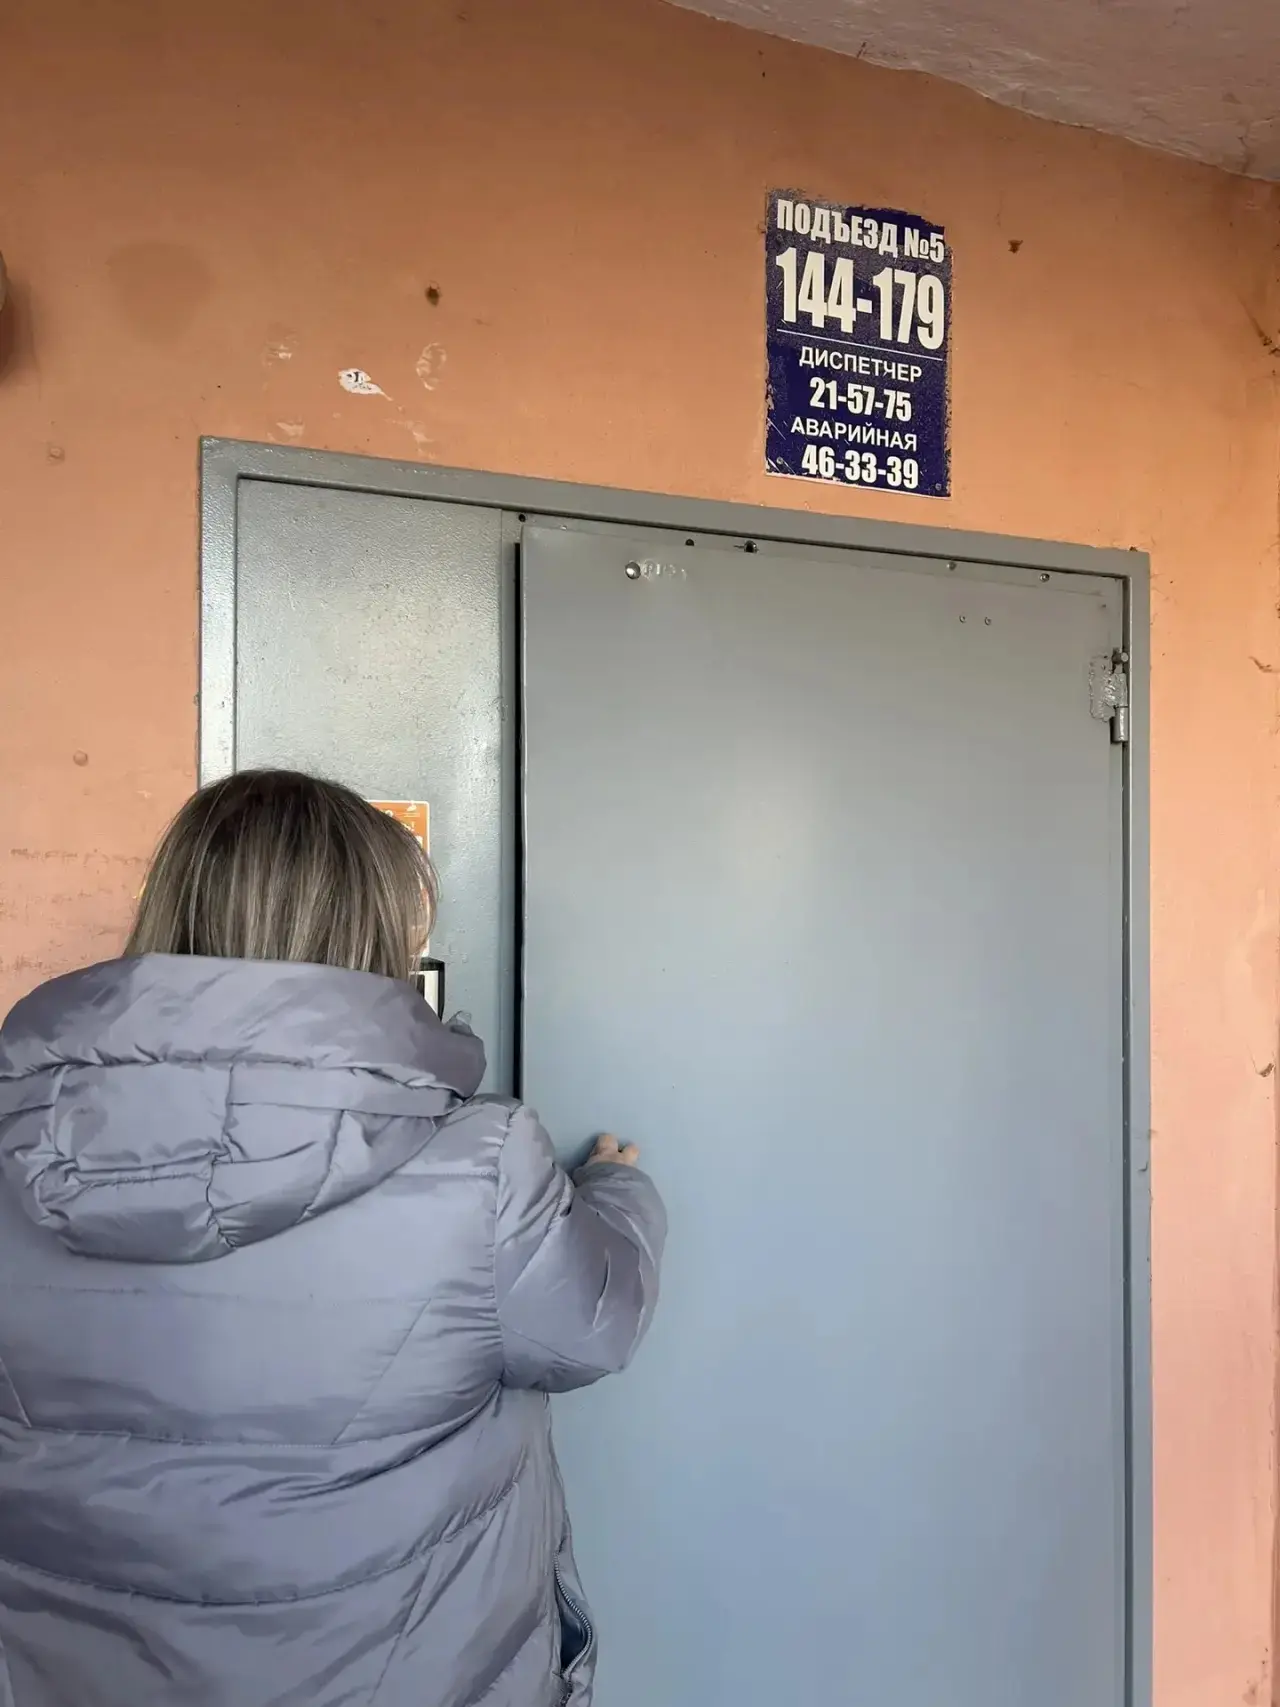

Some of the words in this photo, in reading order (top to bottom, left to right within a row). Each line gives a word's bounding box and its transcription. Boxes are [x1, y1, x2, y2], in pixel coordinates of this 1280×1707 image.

[777, 199, 898, 258] ПОДЪЕЗД
[904, 228, 944, 263] №5
[776, 247, 944, 350] 144-179
[799, 345, 922, 382] ДИСПЕТЧЕР
[809, 377, 912, 422] 21-57-75
[790, 416, 918, 452] АВАРИЙНАЯ
[801, 444, 919, 489] 46-33-39
